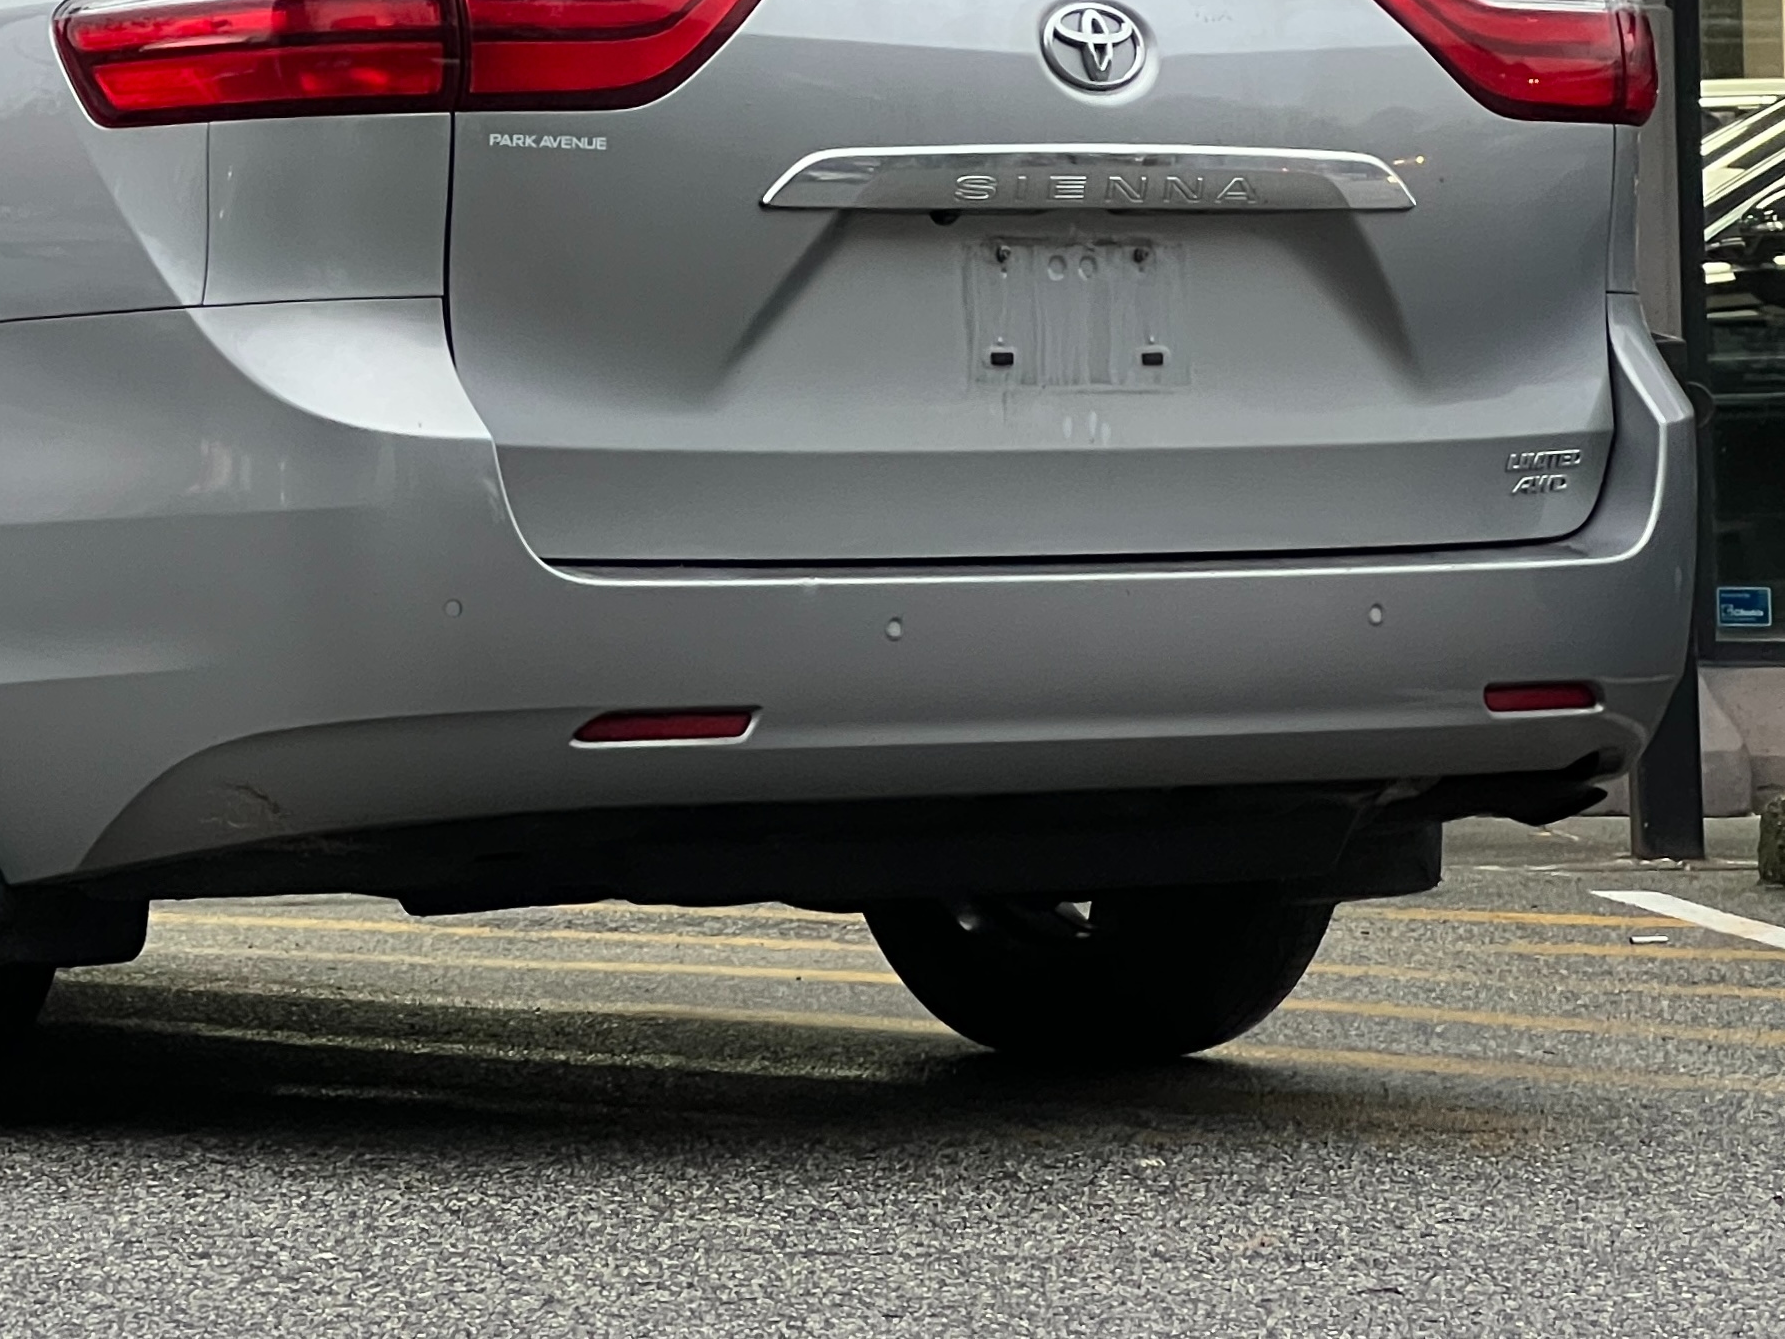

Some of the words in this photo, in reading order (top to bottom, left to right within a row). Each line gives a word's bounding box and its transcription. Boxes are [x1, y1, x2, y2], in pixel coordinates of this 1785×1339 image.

[489, 133, 537, 148] PARK
[539, 135, 607, 150] AVENUE
[954, 174, 1257, 203] SIENNA
